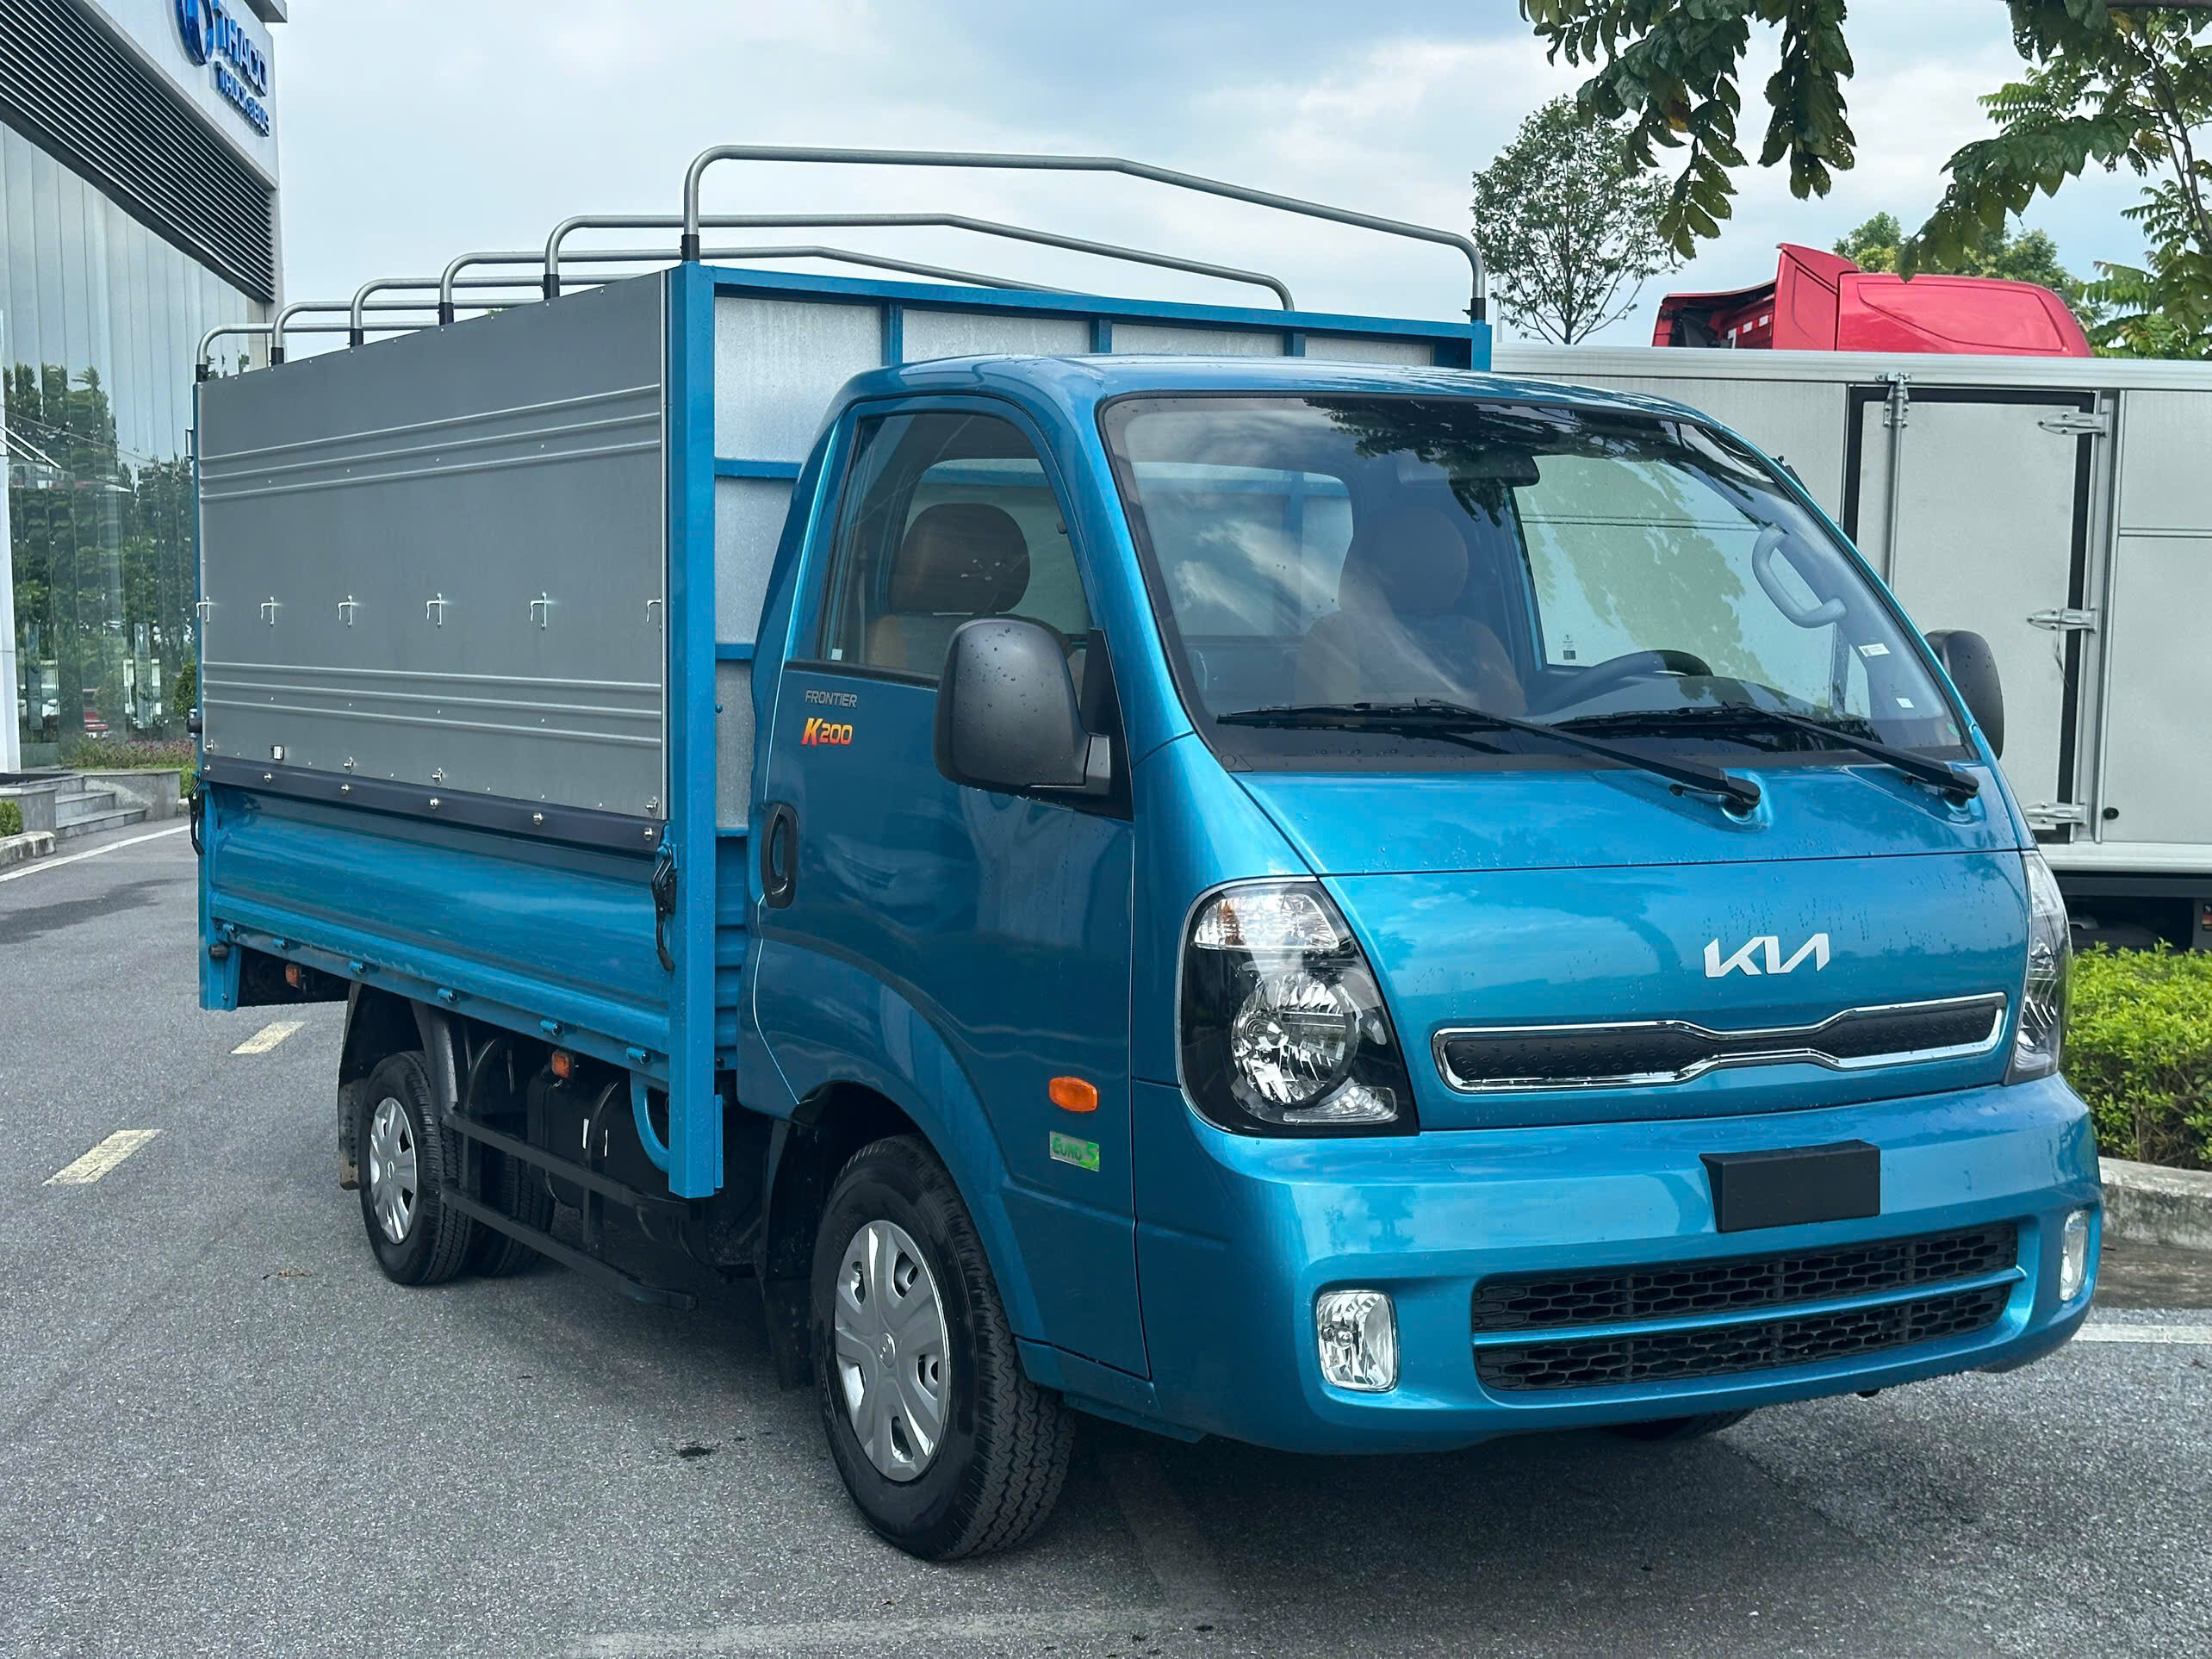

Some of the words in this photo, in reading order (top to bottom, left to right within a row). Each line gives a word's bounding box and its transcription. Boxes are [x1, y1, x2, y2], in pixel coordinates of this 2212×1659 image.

[213, 0, 268, 96] THACO
[805, 690, 857, 707] FRONTIER
[801, 718, 853, 746] K200
[1704, 933, 1830, 979] KIA
